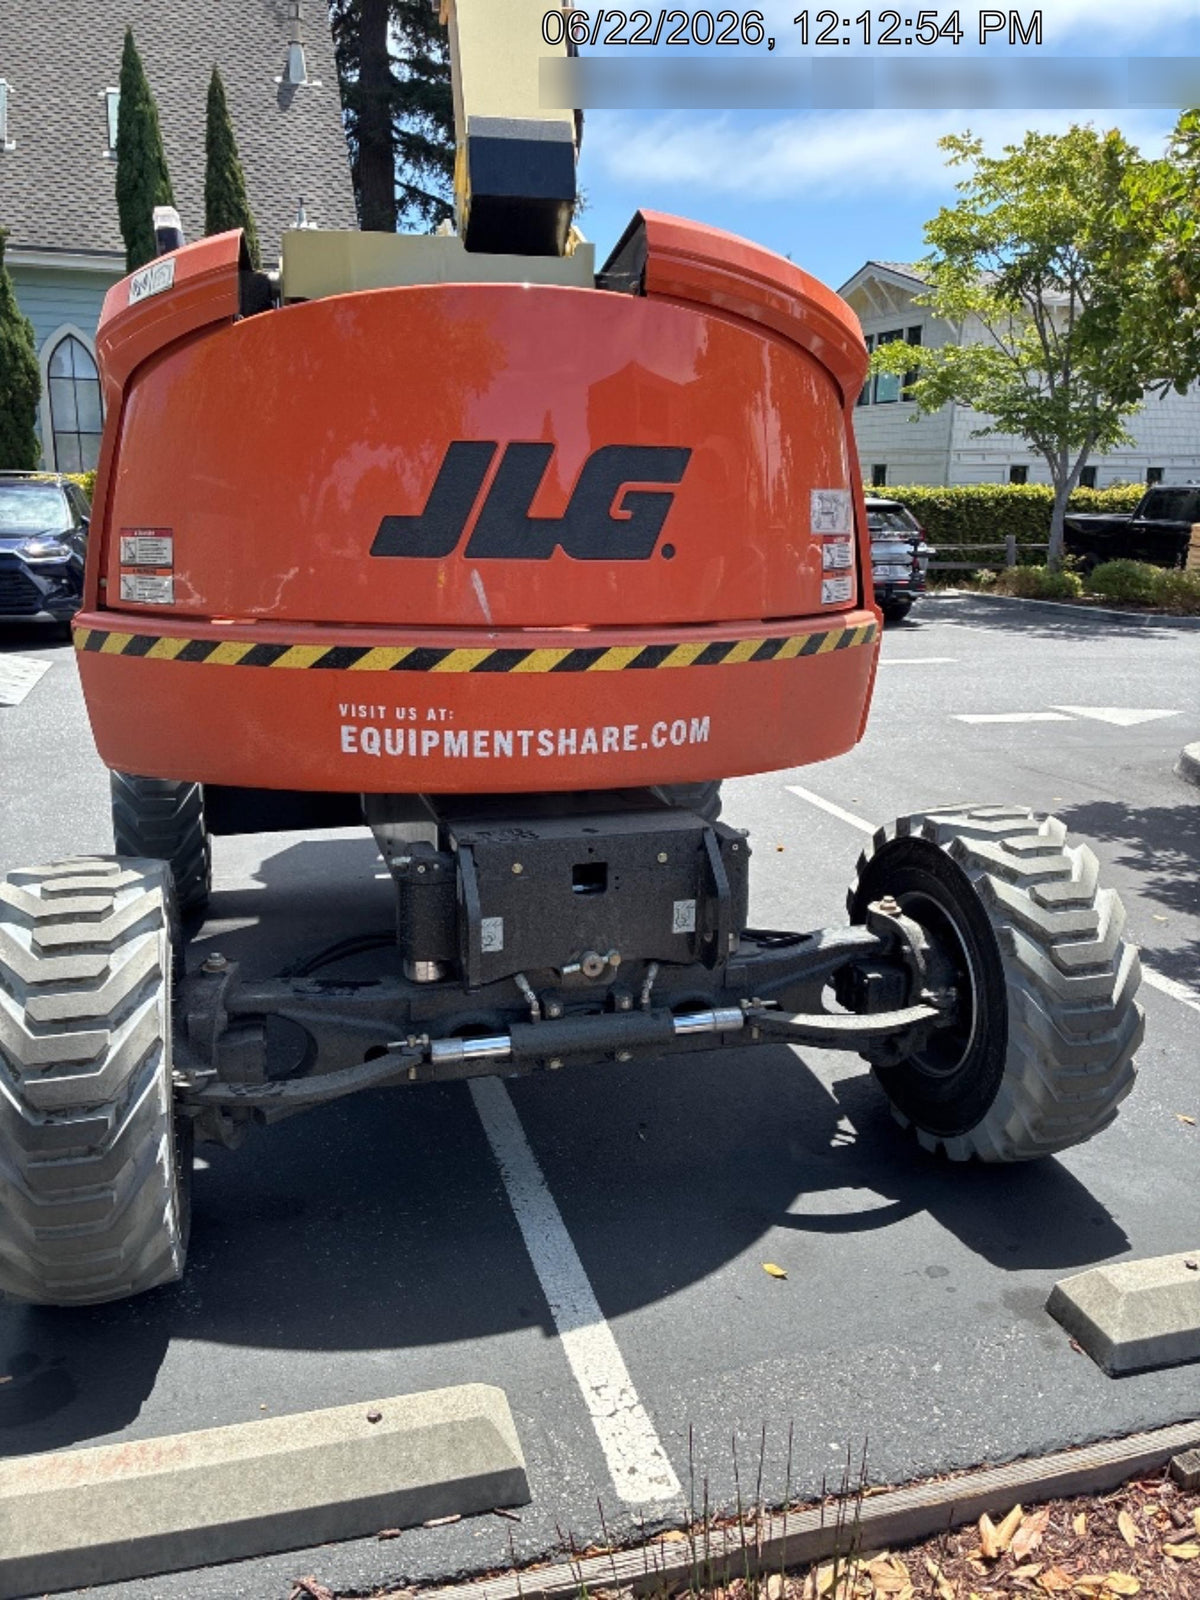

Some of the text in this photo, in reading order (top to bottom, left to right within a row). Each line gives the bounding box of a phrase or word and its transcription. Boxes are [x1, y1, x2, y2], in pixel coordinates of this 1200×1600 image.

[338, 703, 454, 722] VISIT US AT:
[340, 715, 711, 759] EQUIPMENTSHARE.COM
